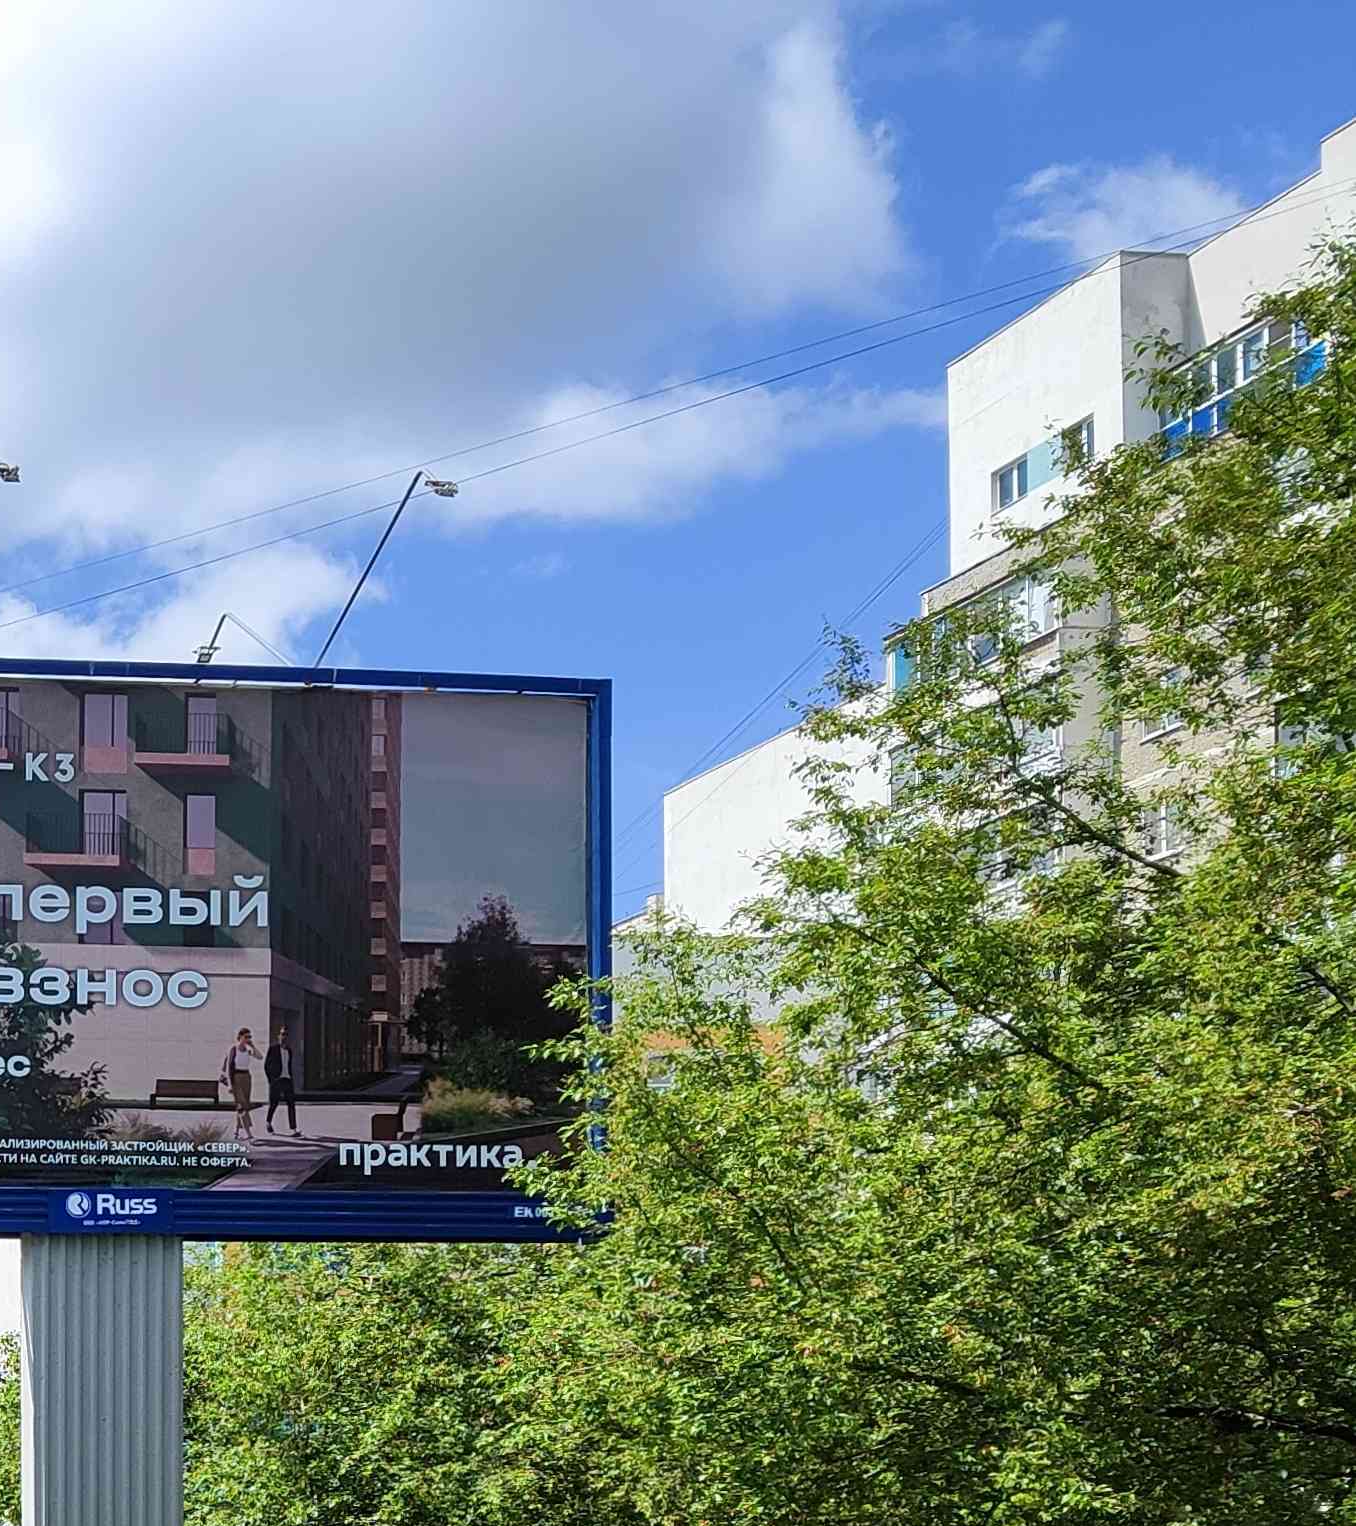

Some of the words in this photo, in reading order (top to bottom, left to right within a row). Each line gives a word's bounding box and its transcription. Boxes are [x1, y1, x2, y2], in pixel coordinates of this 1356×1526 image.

[111, 1139, 195, 1154] ЗАСТРОЙЩИК
[20, 1153, 38, 1163] НА
[39, 1152, 78, 1165] САЙТЕ
[182, 1156, 198, 1167] НЕ
[200, 1156, 252, 1168] ОФЕРТА.
[96, 1193, 158, 1215] Russ
